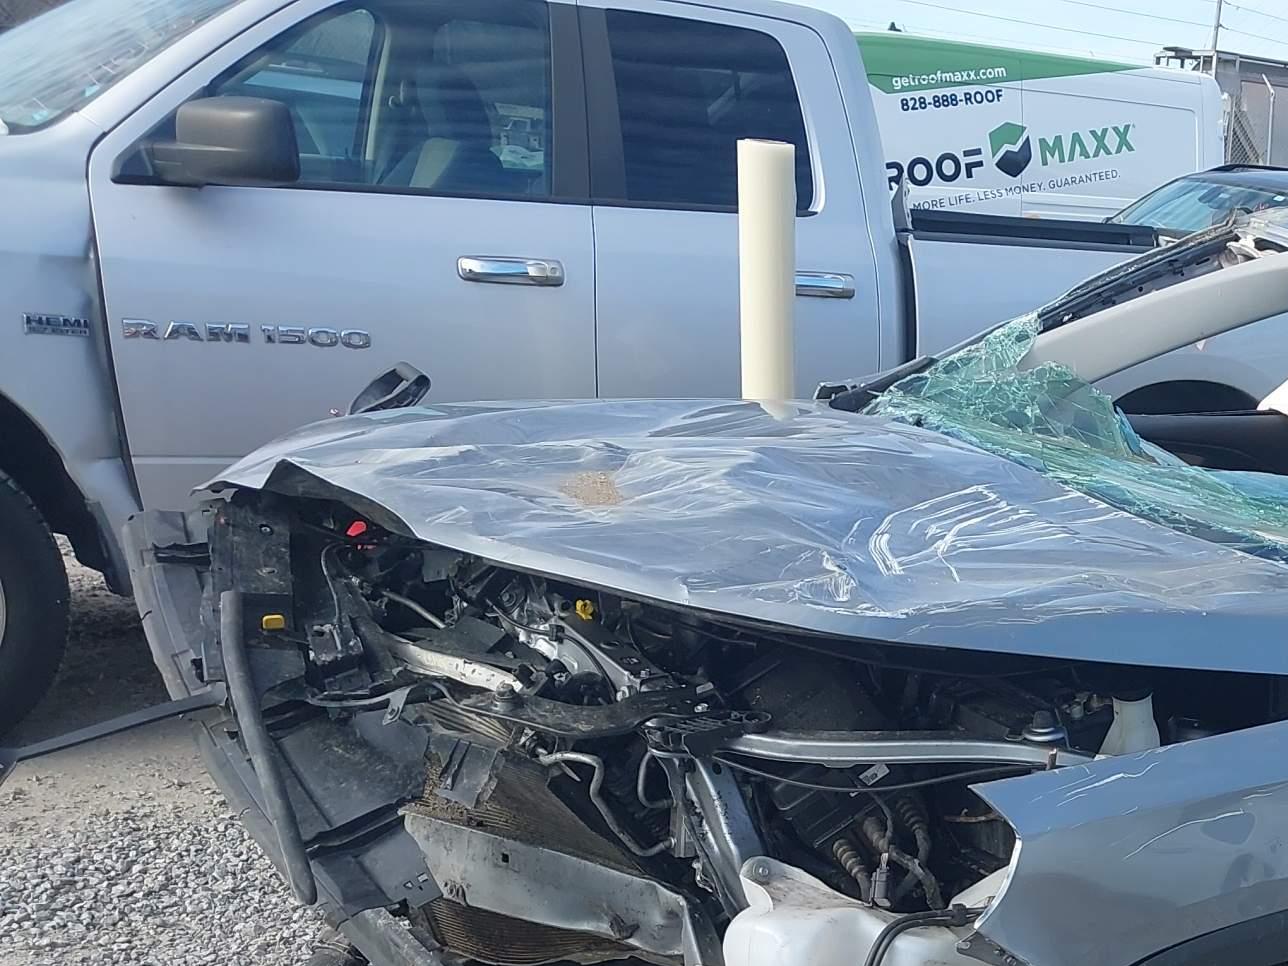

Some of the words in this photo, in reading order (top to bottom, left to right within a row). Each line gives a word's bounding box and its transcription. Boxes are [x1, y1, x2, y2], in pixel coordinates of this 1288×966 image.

[892, 67, 1006, 89] getroofmaxx.com
[900, 89, 1003, 111] 828-888-ROOF
[1038, 123, 1135, 167] MAXX
[949, 194, 975, 207] LIFE.
[977, 188, 1003, 201] LESS
[1005, 181, 1047, 196] MONEY.
[1048, 169, 1121, 190] GUARANTEED.
[25, 315, 89, 328] HEMI
[122, 318, 251, 343] RAM
[261, 323, 371, 349] 1500
